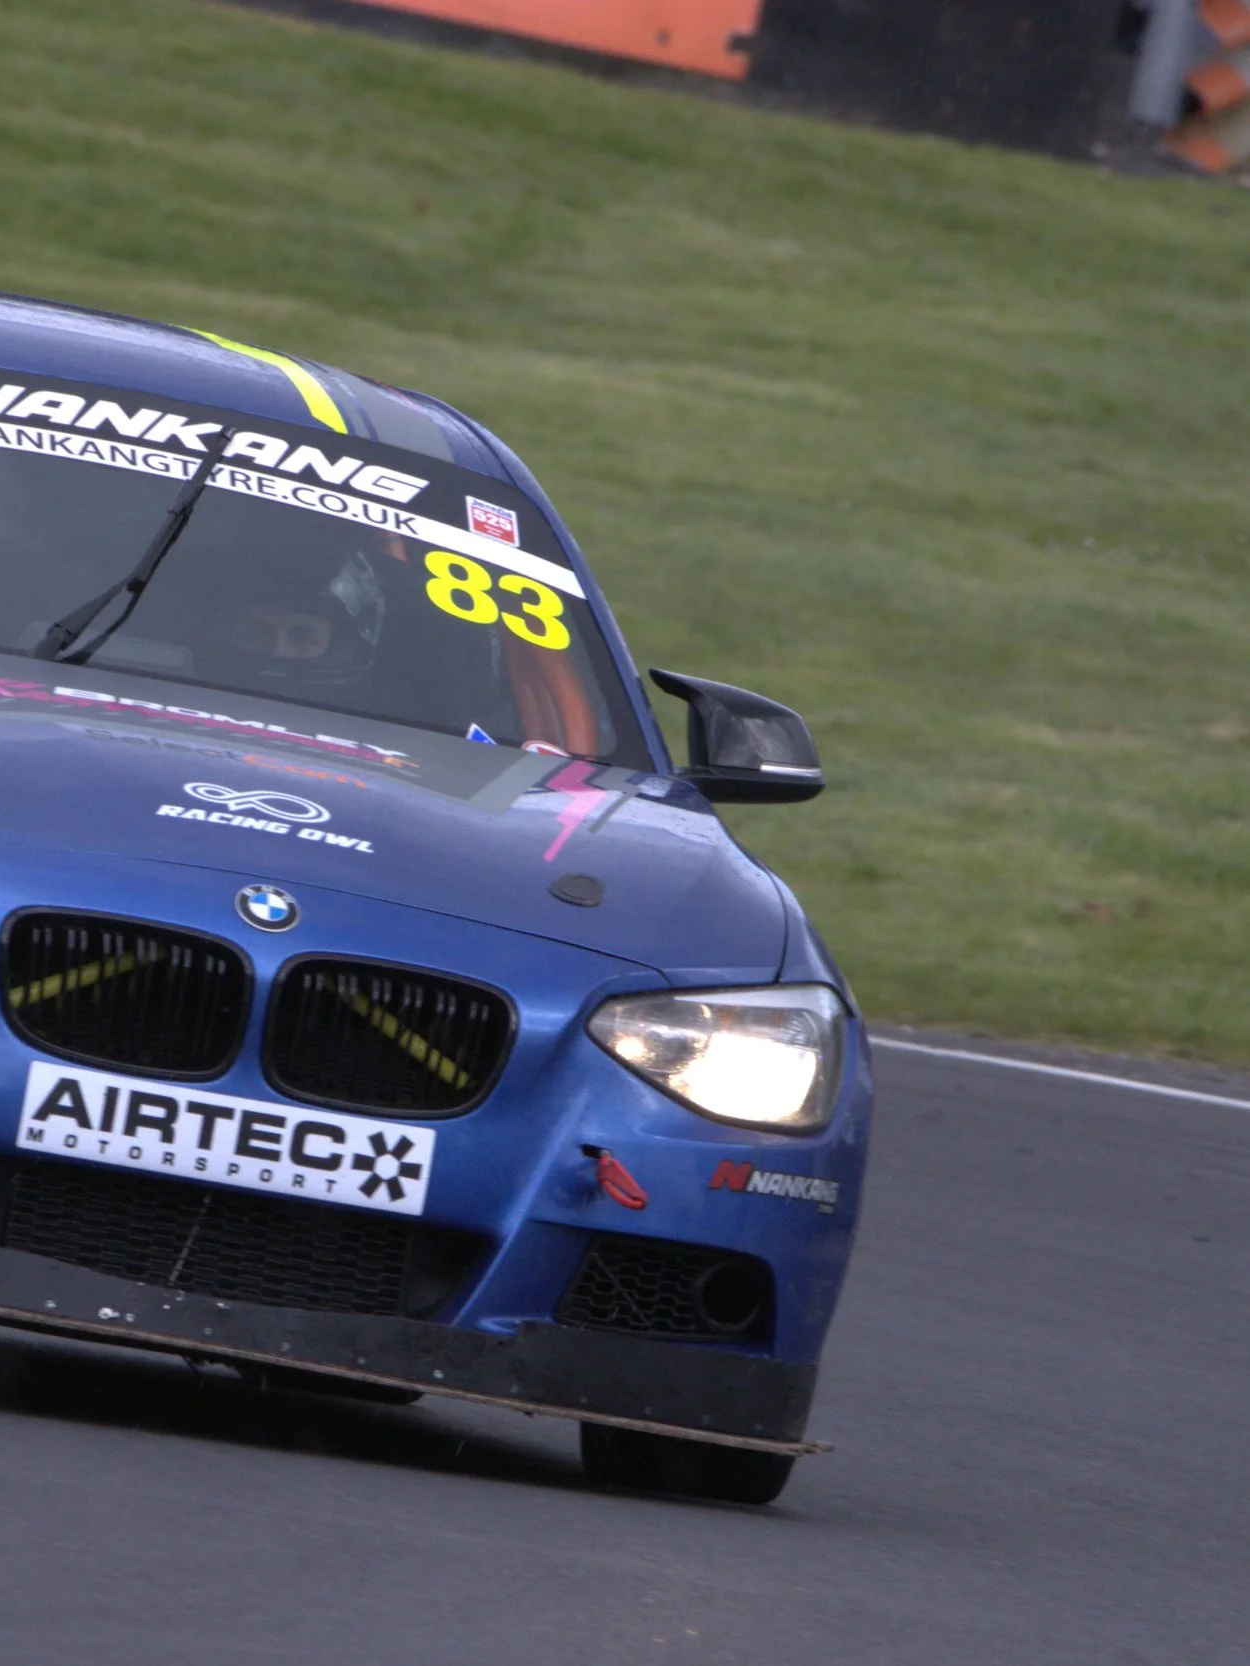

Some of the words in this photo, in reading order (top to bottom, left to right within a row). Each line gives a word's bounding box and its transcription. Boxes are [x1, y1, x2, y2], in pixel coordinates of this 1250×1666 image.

[473, 508, 513, 532] 525
[424, 550, 571, 651] 83
[53, 686, 410, 757] BROMLEY
[155, 804, 292, 834] RACING
[297, 828, 375, 853] OWL
[31, 1077, 347, 1172] AIRTEC
[26, 1127, 338, 1194] MOTORSPORT
